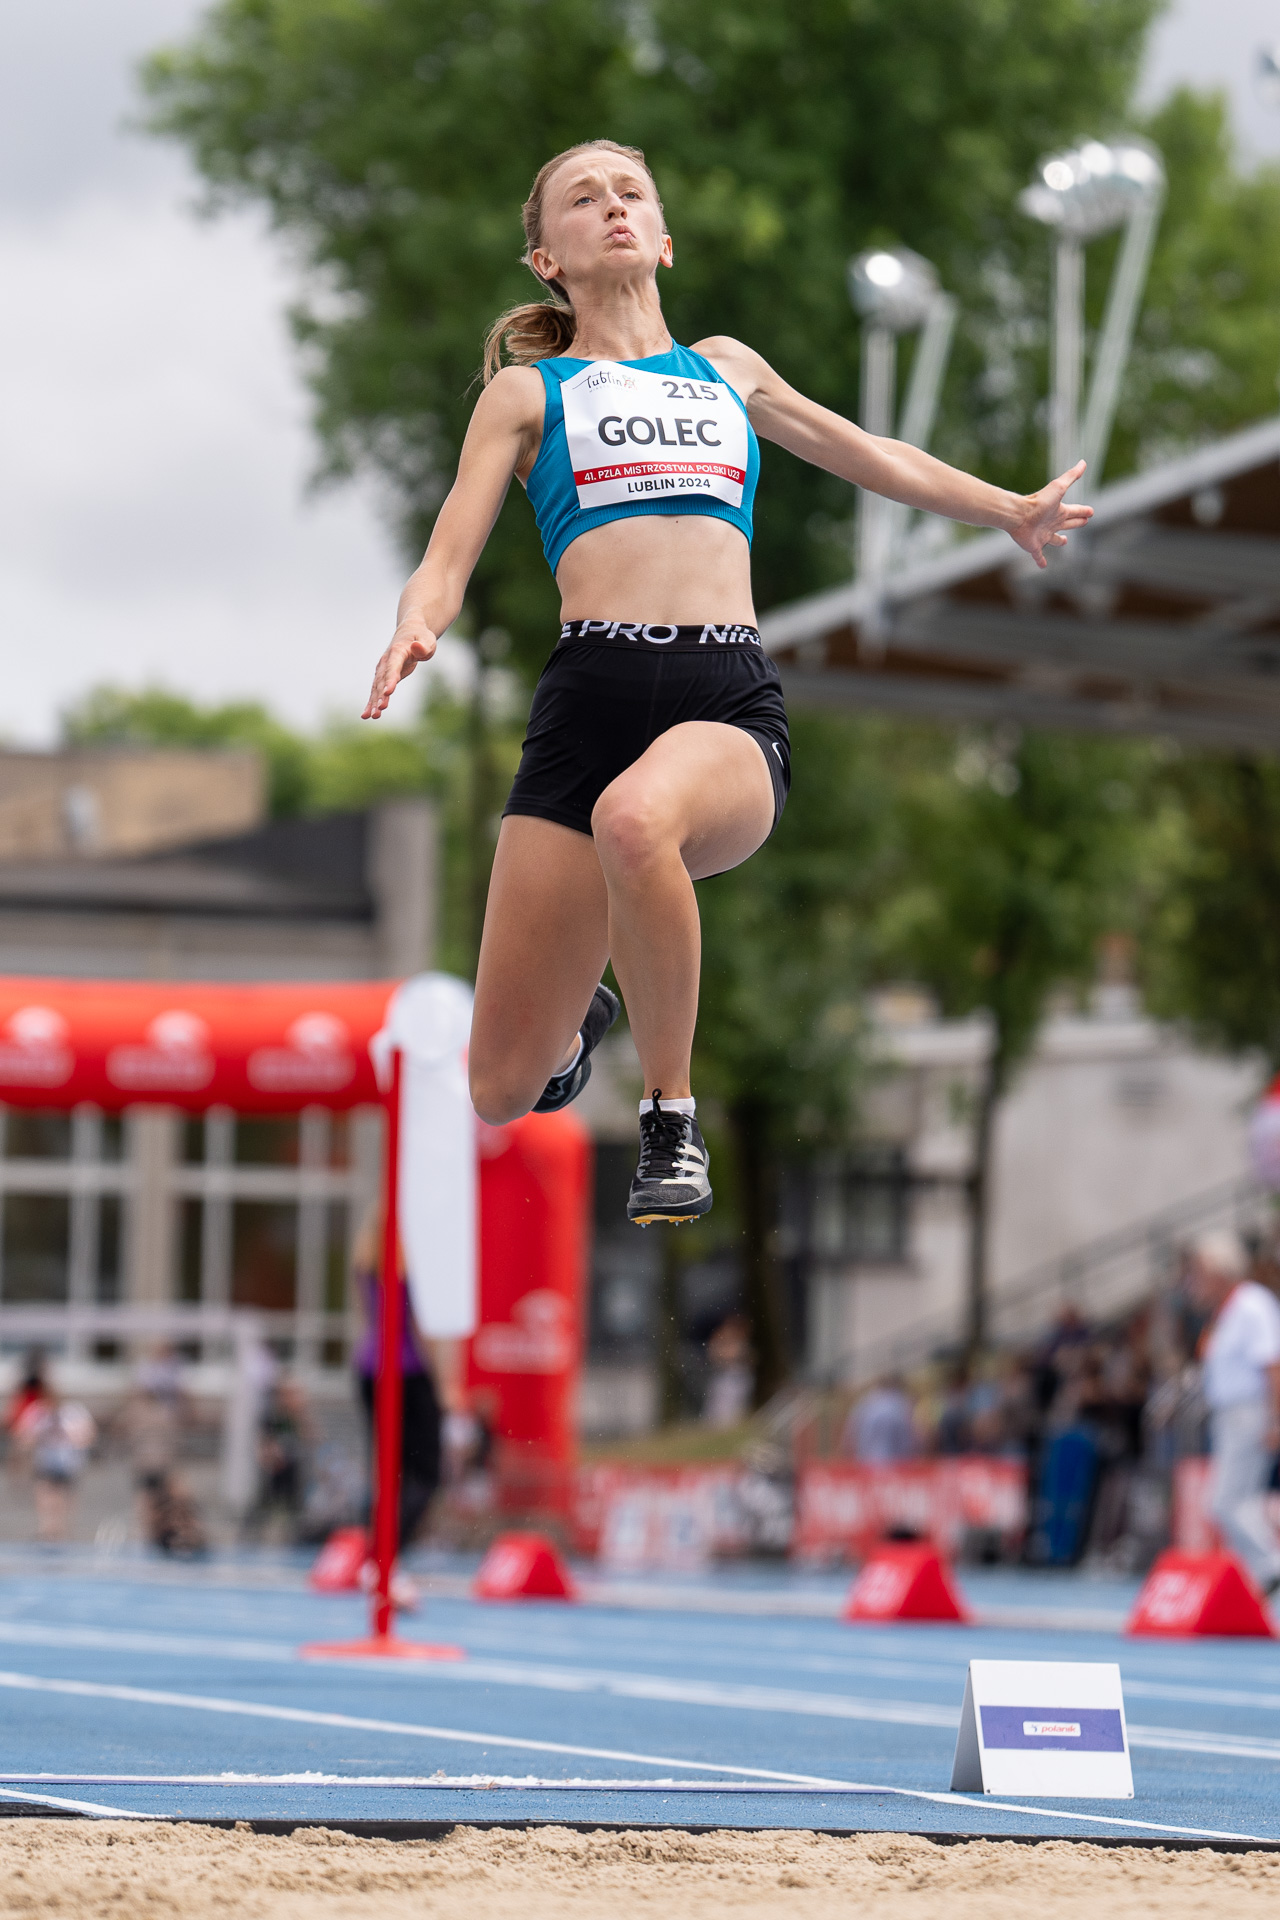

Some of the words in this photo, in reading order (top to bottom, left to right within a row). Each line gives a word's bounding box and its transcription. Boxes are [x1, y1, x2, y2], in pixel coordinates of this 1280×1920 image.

[661, 380, 719, 401] 215
[597, 415, 722, 447] GOLEC
[584, 472, 597, 482] 41.
[598, 466, 622, 480] PZLA
[623, 463, 694, 476] MISTRZOSTWA
[696, 464, 726, 475] POLSKI
[727, 467, 741, 480] U23
[627, 480, 675, 494] LUBLIN
[678, 477, 711, 490] 2024
[578, 619, 679, 644] PRO
